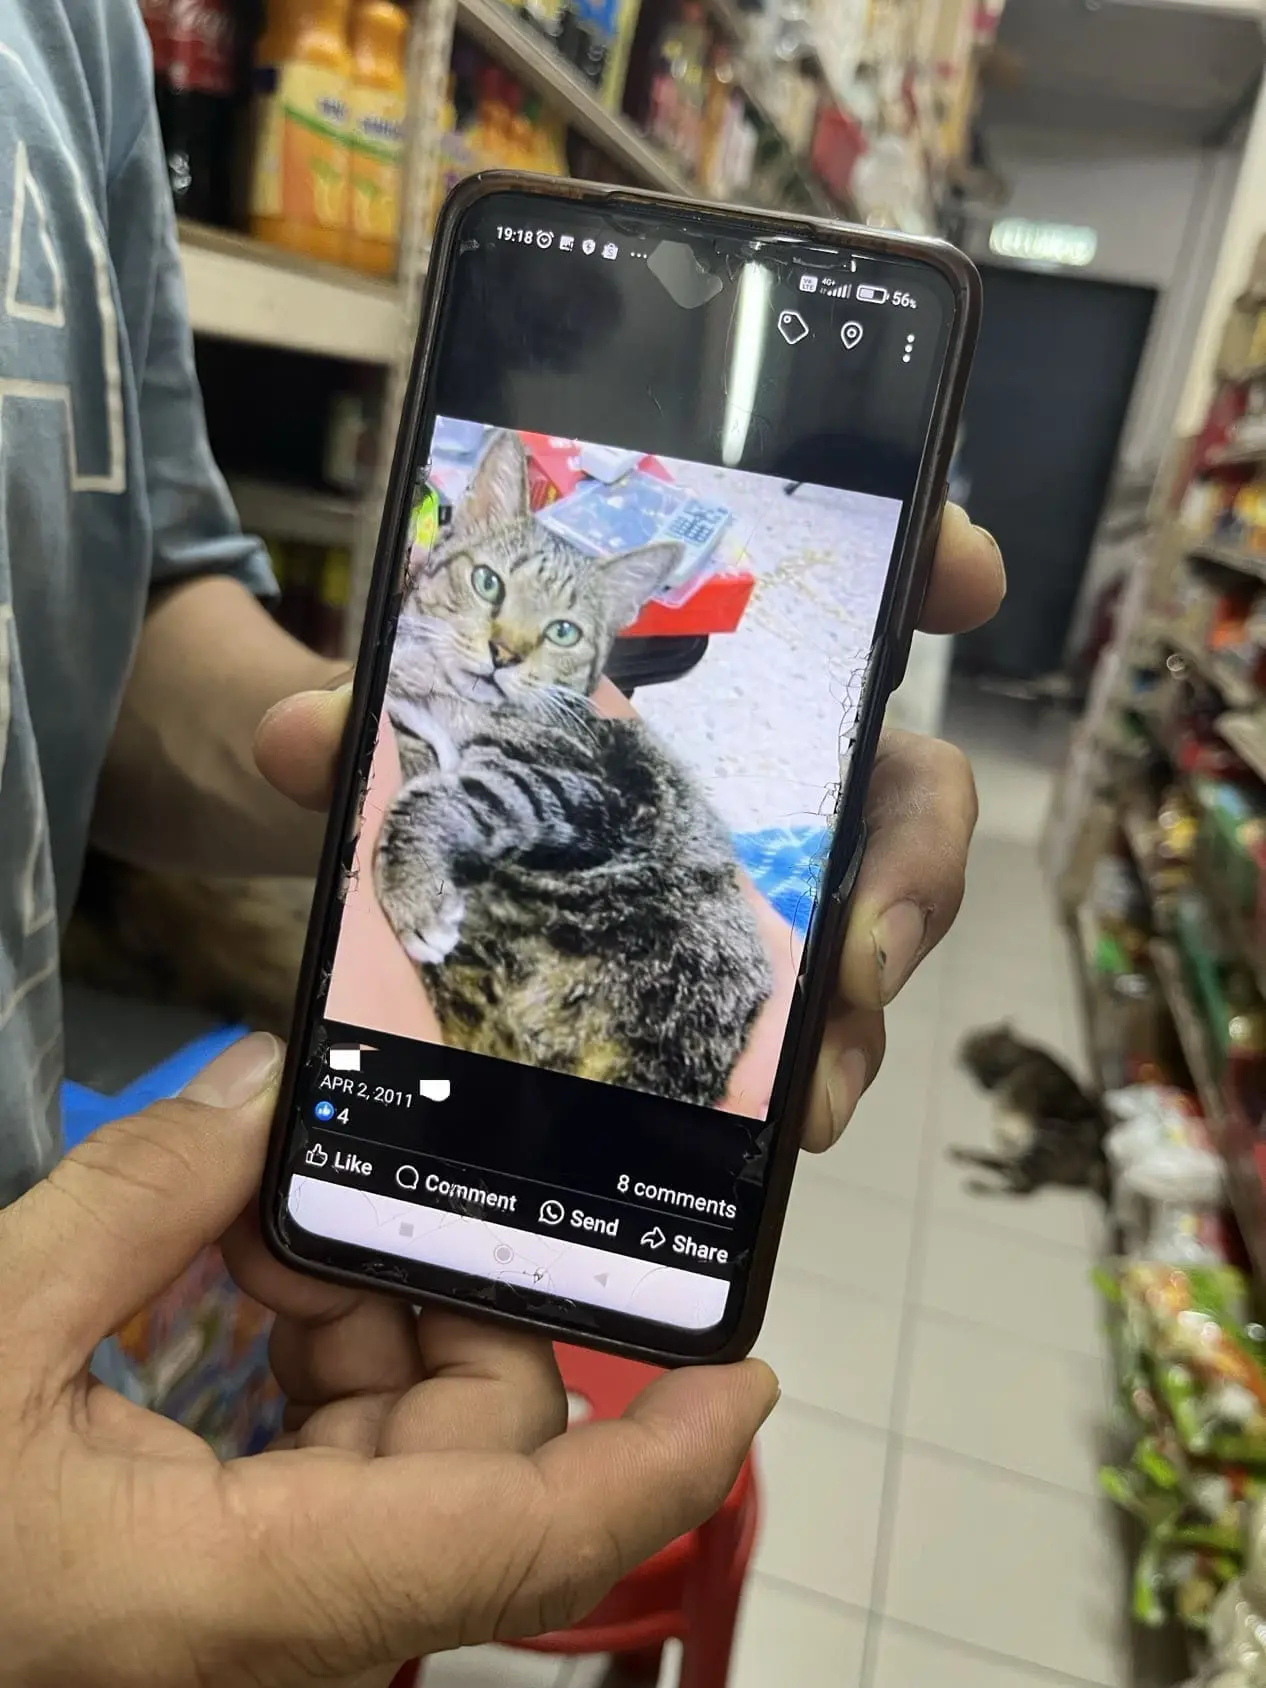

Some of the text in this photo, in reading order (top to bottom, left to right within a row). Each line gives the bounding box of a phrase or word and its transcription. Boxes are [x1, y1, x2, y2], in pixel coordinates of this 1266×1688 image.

[496, 226, 534, 245] 19:18
[891, 290, 917, 309] 56%
[320, 1074, 413, 1108] APR 2, 2011
[337, 1108, 350, 1124] 4
[333, 1151, 729, 1264] Like Comment Send Share
[617, 1174, 738, 1219] 8 comments
